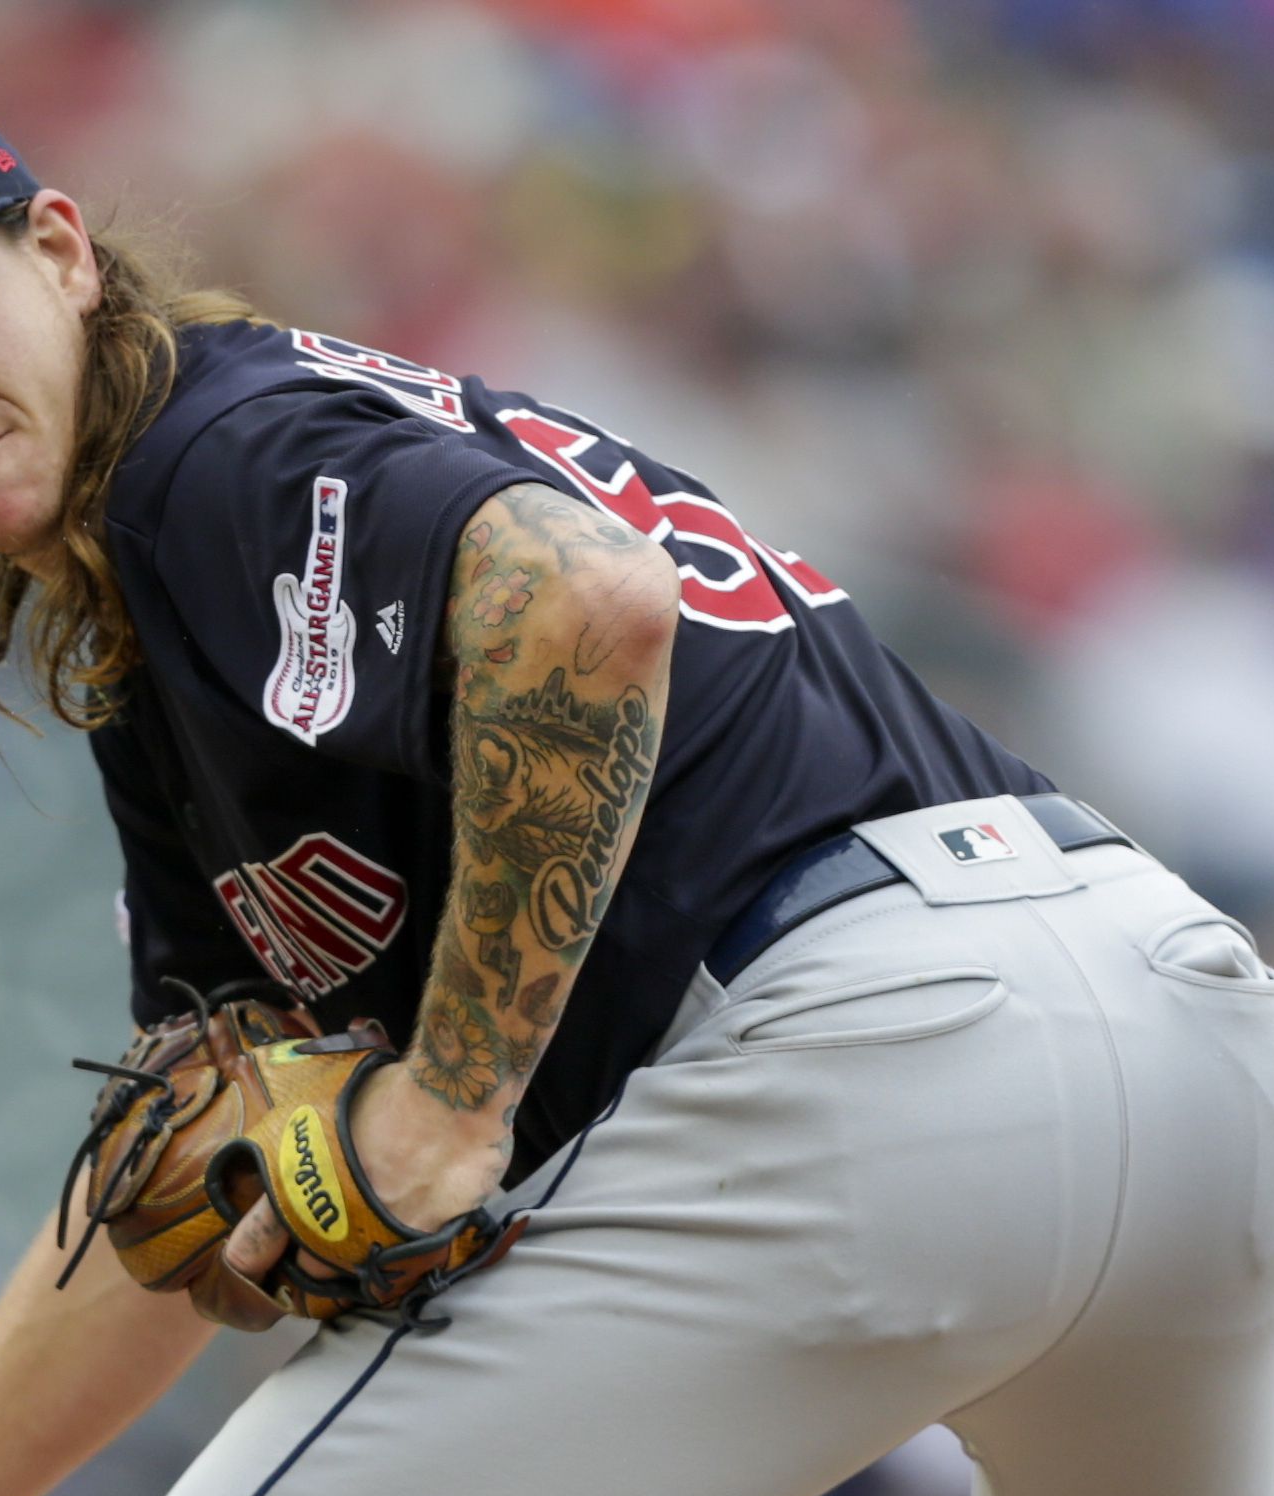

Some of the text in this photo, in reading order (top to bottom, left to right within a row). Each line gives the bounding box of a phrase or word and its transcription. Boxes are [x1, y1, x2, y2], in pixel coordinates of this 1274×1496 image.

[307, 536, 337, 612] GAME
[327, 648, 338, 691] 2019
[533, 692, 652, 948] Penelope
[293, 1115, 340, 1232] Wilson
